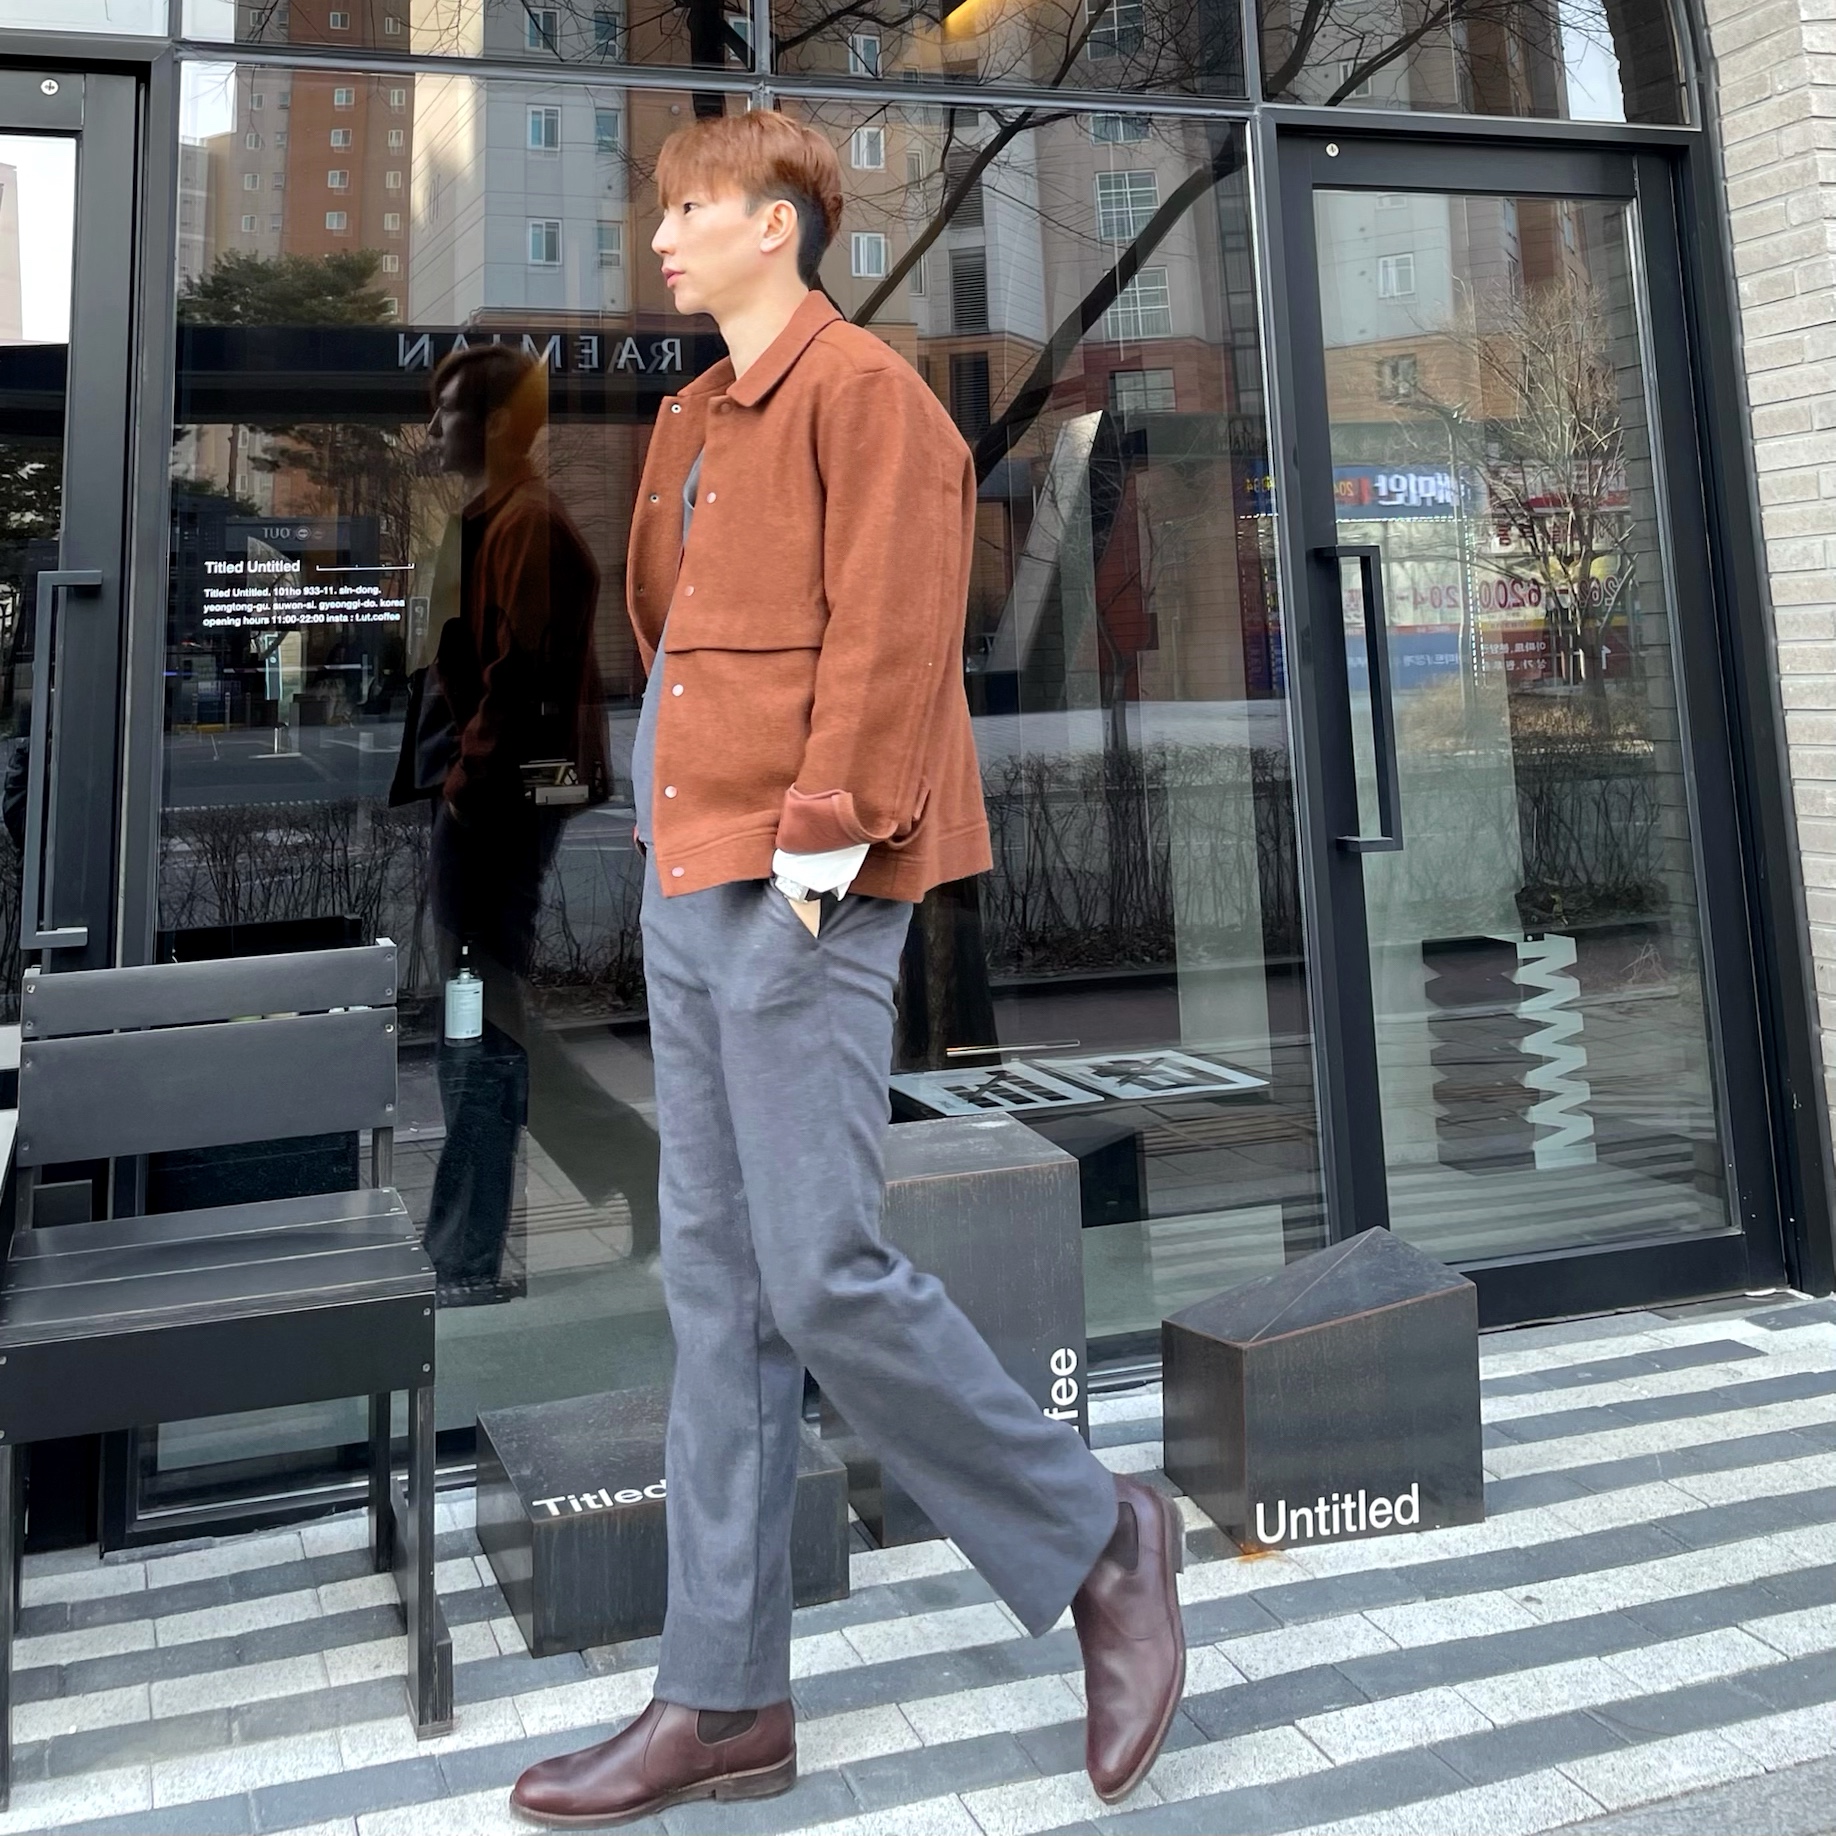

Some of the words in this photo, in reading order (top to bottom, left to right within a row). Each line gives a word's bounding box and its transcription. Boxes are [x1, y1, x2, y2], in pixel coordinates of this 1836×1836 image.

[204, 561, 244, 574] Titled
[247, 560, 301, 573] Untitled
[203, 588, 230, 598] Titled
[380, 598, 406, 608] korea
[203, 616, 242, 627] opening
[243, 615, 271, 625] hours
[272, 613, 325, 624] 11:00-22:00
[326, 612, 349, 623] insta
[1043, 1347, 1079, 1434] fee
[532, 1479, 667, 1516] Titled
[1255, 1482, 1420, 1544] Untitled
